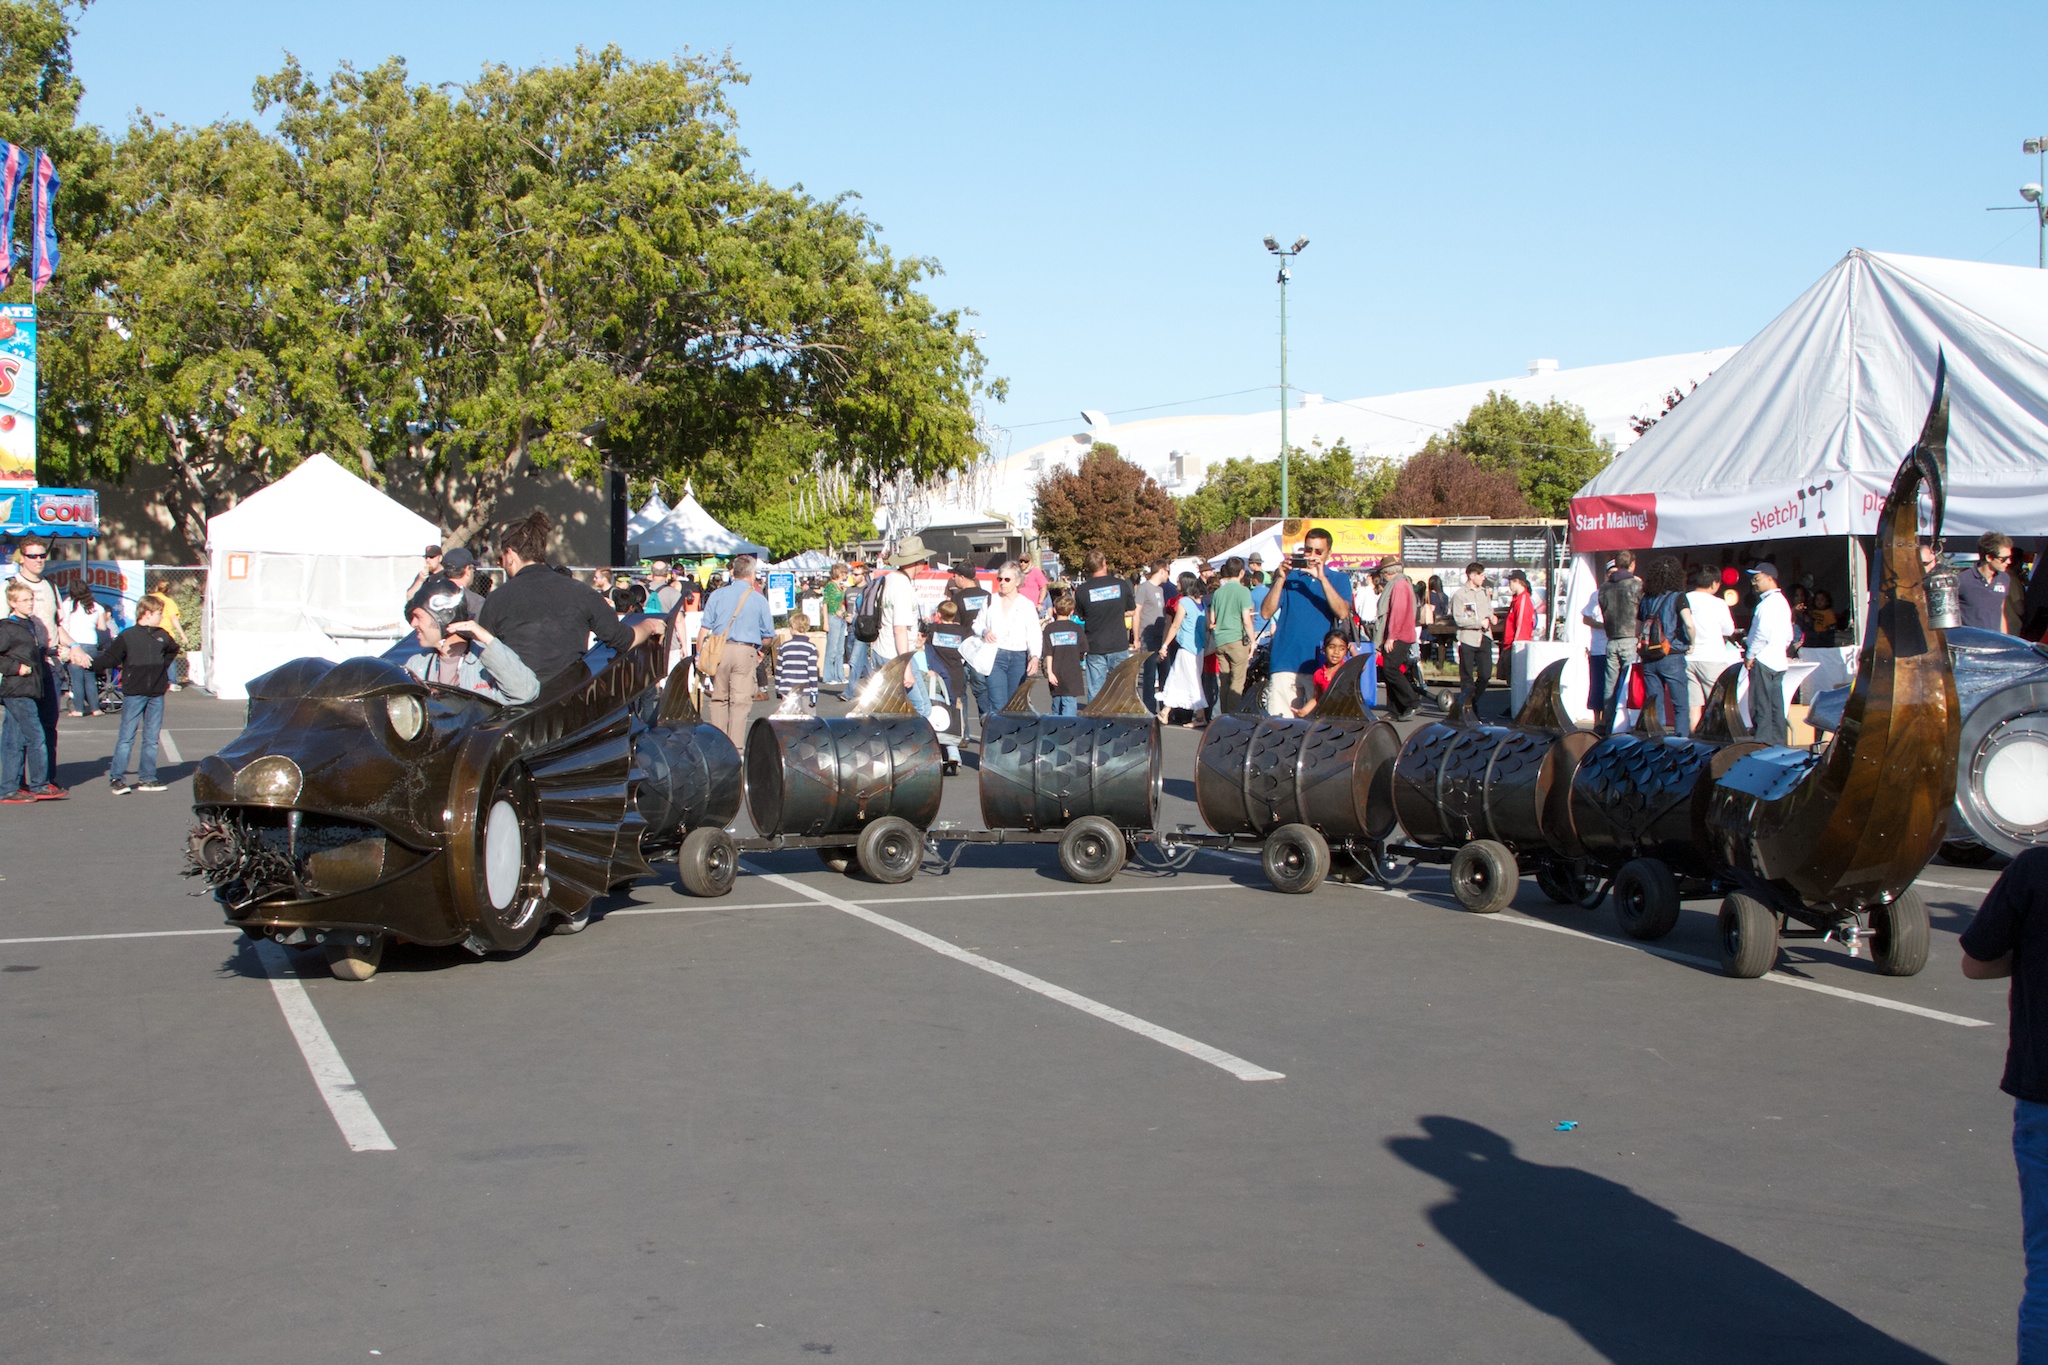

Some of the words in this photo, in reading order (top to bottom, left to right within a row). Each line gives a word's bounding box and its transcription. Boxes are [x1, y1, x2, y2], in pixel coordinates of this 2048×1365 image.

[1862, 489, 1887, 516] pla
[1017, 511, 1030, 527] 15
[1575, 513, 1604, 531] Start
[1606, 510, 1649, 531] Making!
[1750, 500, 1798, 534] sketch
[1341, 554, 1376, 562] Burgers
